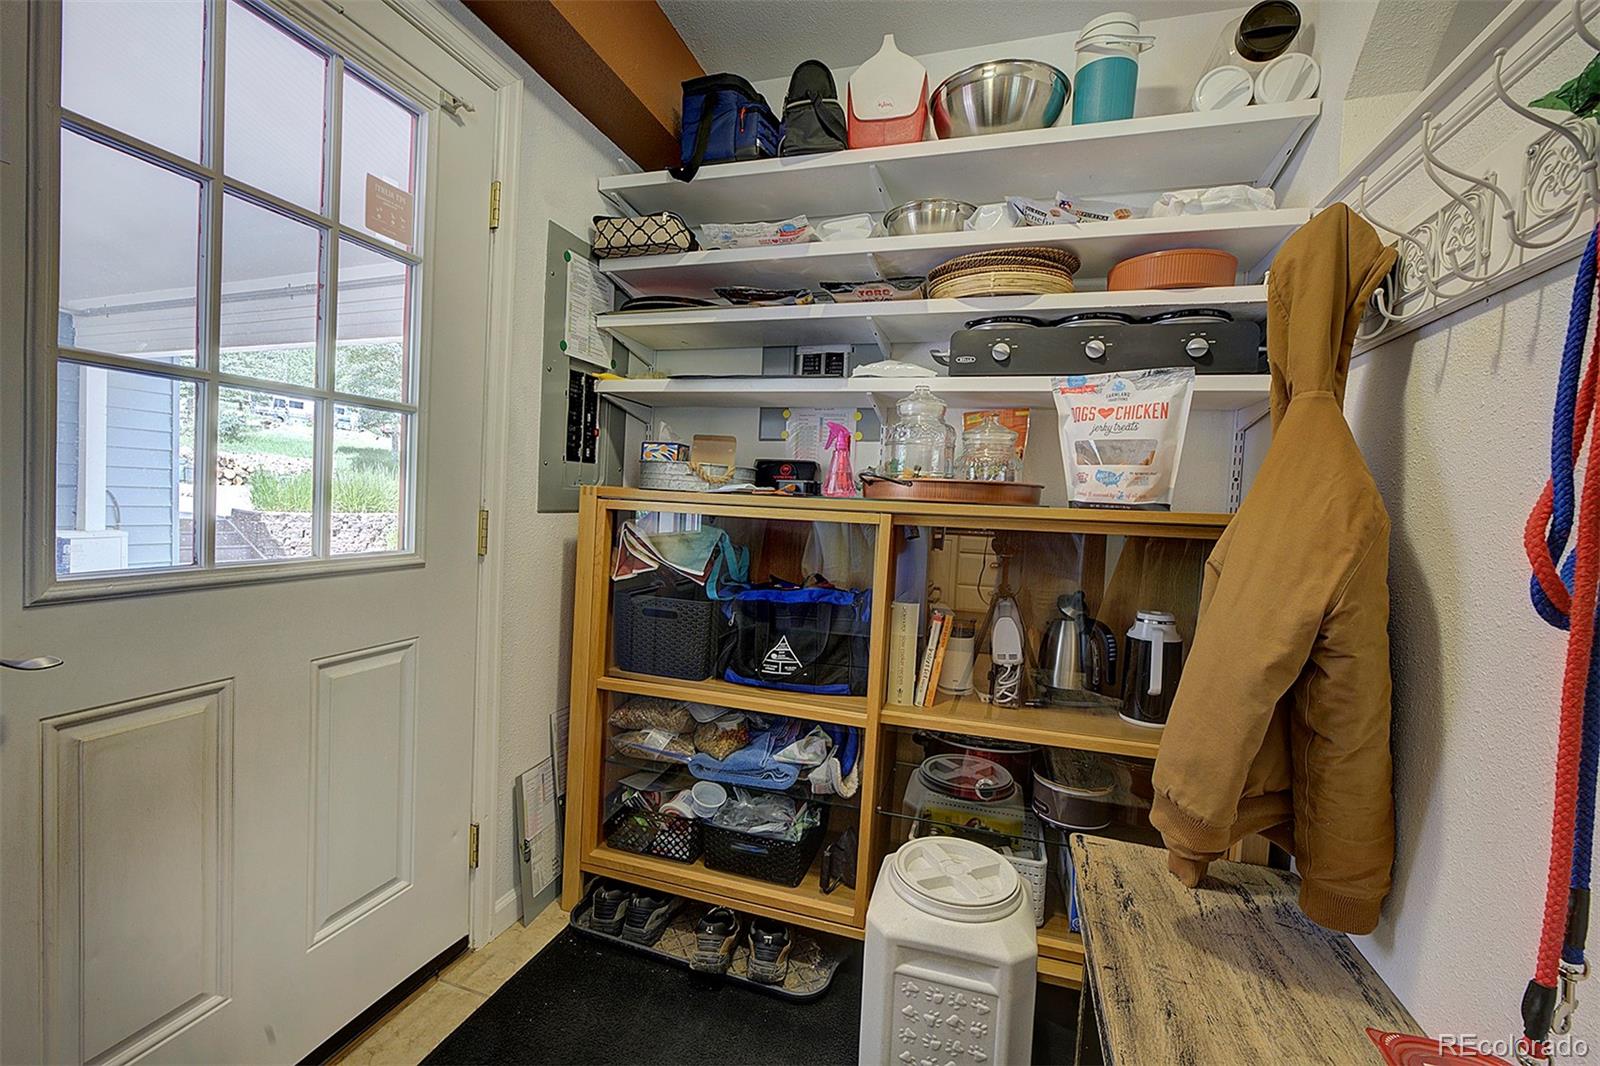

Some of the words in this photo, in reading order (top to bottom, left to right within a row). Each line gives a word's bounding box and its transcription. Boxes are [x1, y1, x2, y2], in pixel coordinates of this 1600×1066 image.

[1115, 402, 1169, 420] CHICKEN
[1089, 422, 1113, 436] jerky
[1113, 421, 1140, 431] treats
